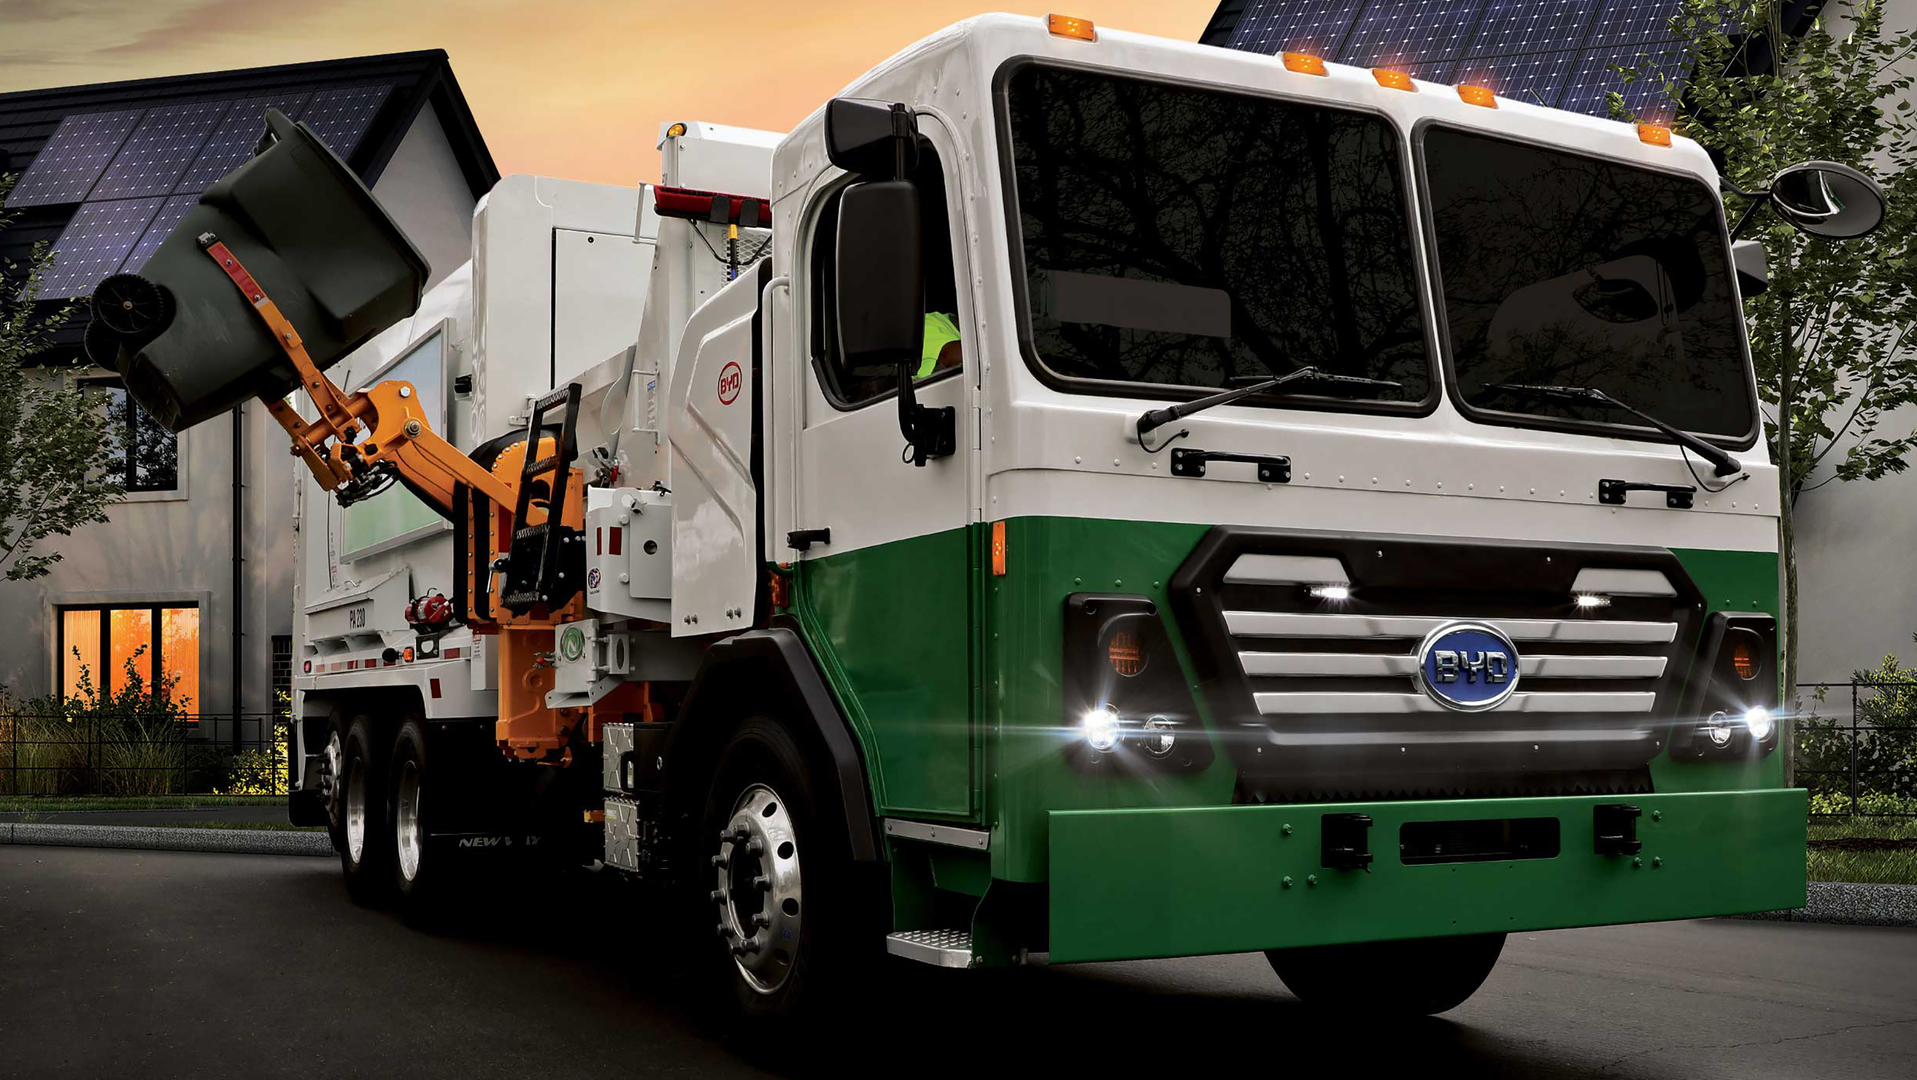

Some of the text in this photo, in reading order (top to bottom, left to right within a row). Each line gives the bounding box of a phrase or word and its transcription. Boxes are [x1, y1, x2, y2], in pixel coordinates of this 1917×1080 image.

[720, 372, 739, 395] BYD
[1434, 650, 1507, 683] BYD
[459, 836, 501, 848] NEW
